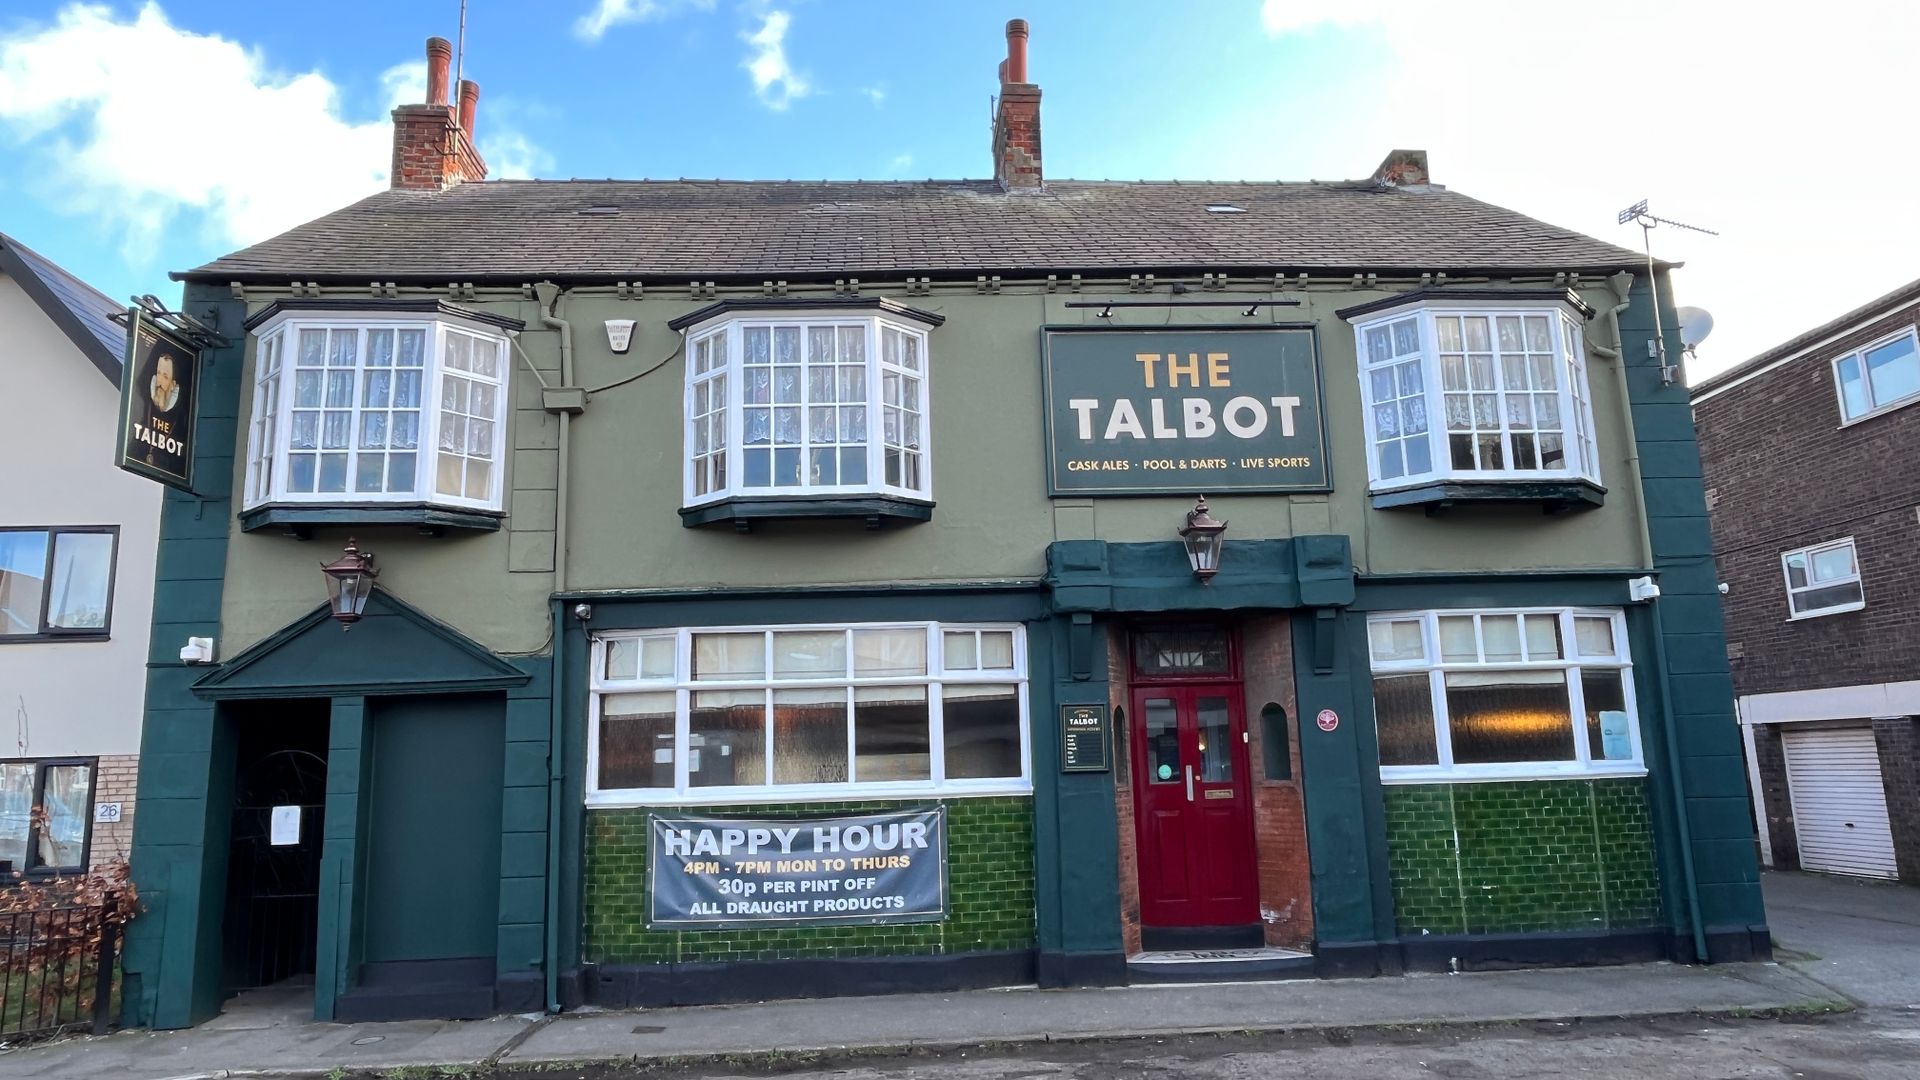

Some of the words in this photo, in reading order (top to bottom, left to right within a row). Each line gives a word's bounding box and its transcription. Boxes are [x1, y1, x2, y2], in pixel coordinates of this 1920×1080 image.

[1135, 353, 1231, 388] THE
[152, 416, 170, 433] THE
[1069, 396, 1300, 439] TALBOT
[134, 423, 184, 456] TALBOT
[1067, 460, 1099, 472] CASK
[1102, 460, 1130, 471] ALES
[1143, 459, 1176, 470] POOL
[1178, 459, 1187, 470] &
[1190, 458, 1227, 469] DARTS
[1241, 458, 1264, 469] LIVE
[1268, 457, 1310, 468] SPORTS
[100, 804, 117, 817] 26
[665, 828, 800, 856] HAPPY
[813, 822, 929, 853] HOUR
[683, 861, 720, 875] 4PM
[735, 861, 771, 874] 7PM
[776, 859, 817, 873] MON
[822, 858, 846, 871] TO
[850, 855, 911, 870] THURS
[718, 878, 757, 897] 30p
[763, 881, 796, 894] PER
[800, 879, 839, 893] PINT
[844, 877, 876, 890] OFF
[690, 902, 724, 915] ALL
[726, 900, 808, 915] DRAUGHT
[813, 895, 905, 912] PRODUCTS
